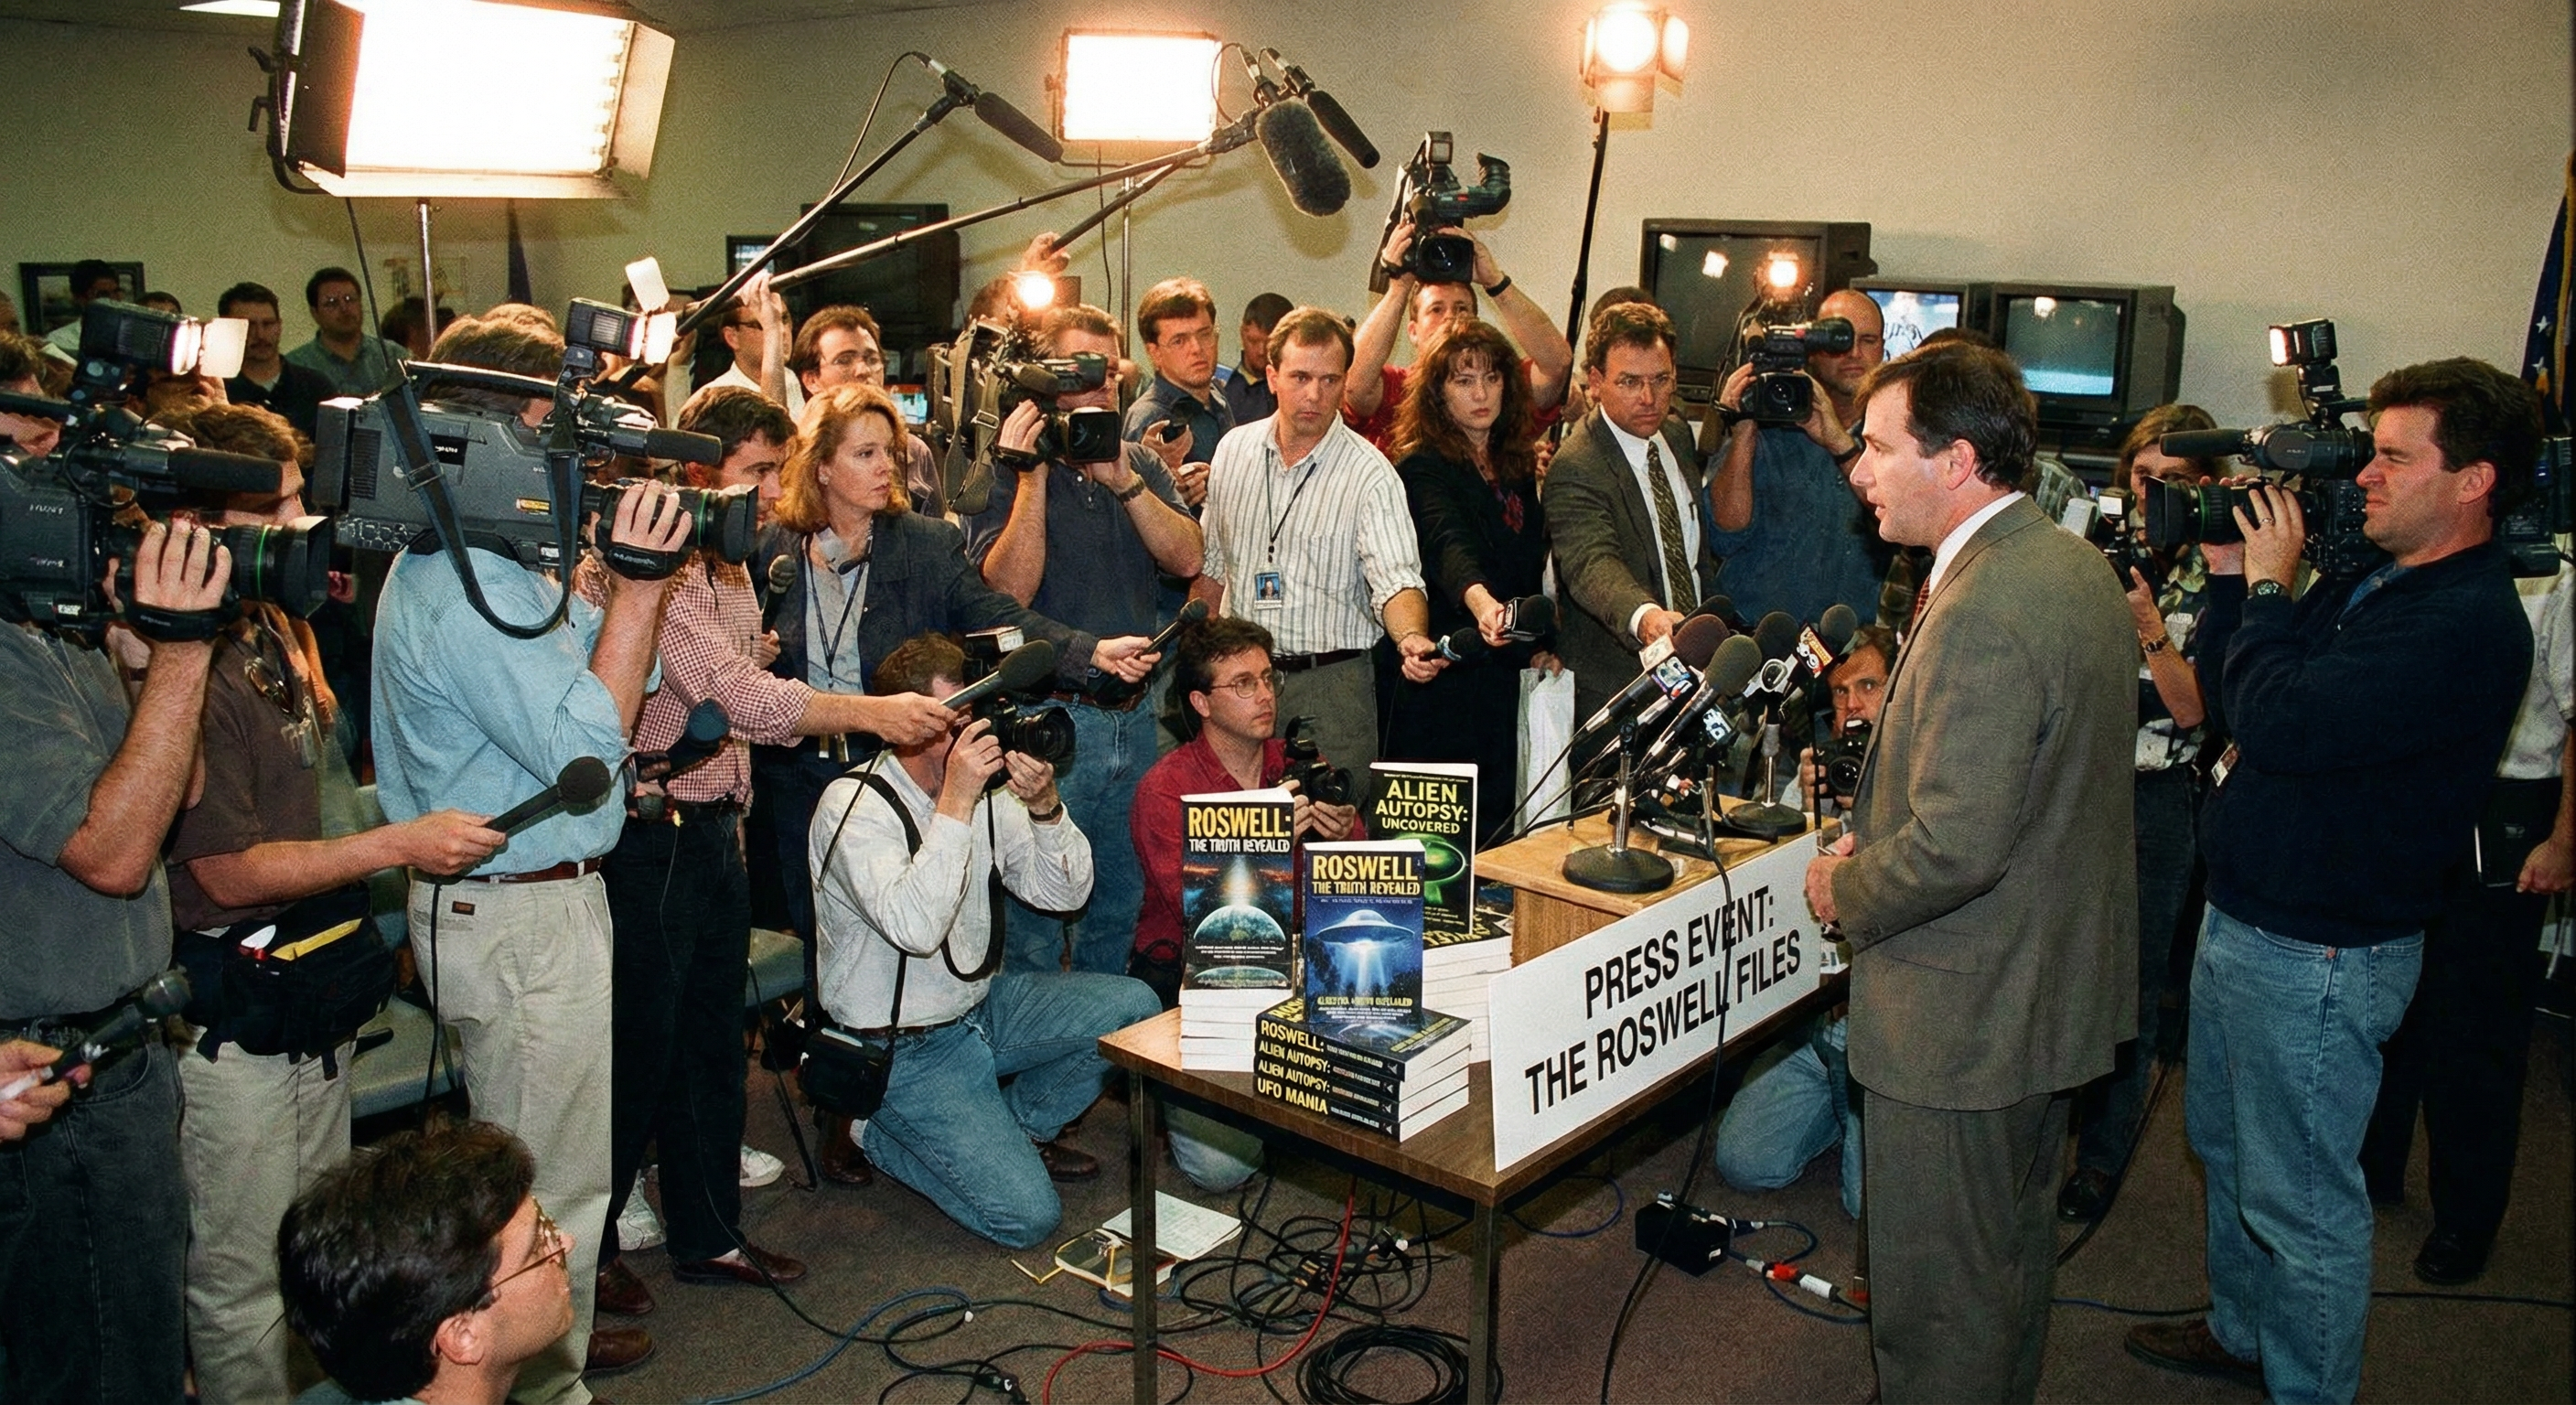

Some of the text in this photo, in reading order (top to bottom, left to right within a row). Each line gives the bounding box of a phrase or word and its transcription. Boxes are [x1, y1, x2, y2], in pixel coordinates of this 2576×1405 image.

[1386, 779, 1457, 803] ALIEN
[1188, 807, 1292, 838] ROSWELL:
[1375, 799, 1468, 821] AUTOPSY:
[1381, 817, 1461, 834] UNCOVERED
[1313, 854, 1419, 881] ROSWELL
[1312, 881, 1421, 896] THE TRUTH REVEALED
[1584, 885, 1774, 1020] PRESS EVENT:
[1524, 928, 1801, 1116] THE ROSWELL FILES
[1261, 1019, 1325, 1053] ROSWELL:
[1286, 1048, 1331, 1074] AUTOPSY:
[1285, 1067, 1330, 1093] AUTOPSY:
[1257, 1078, 1282, 1099] UFO
[1285, 1086, 1328, 1115] MANIA
